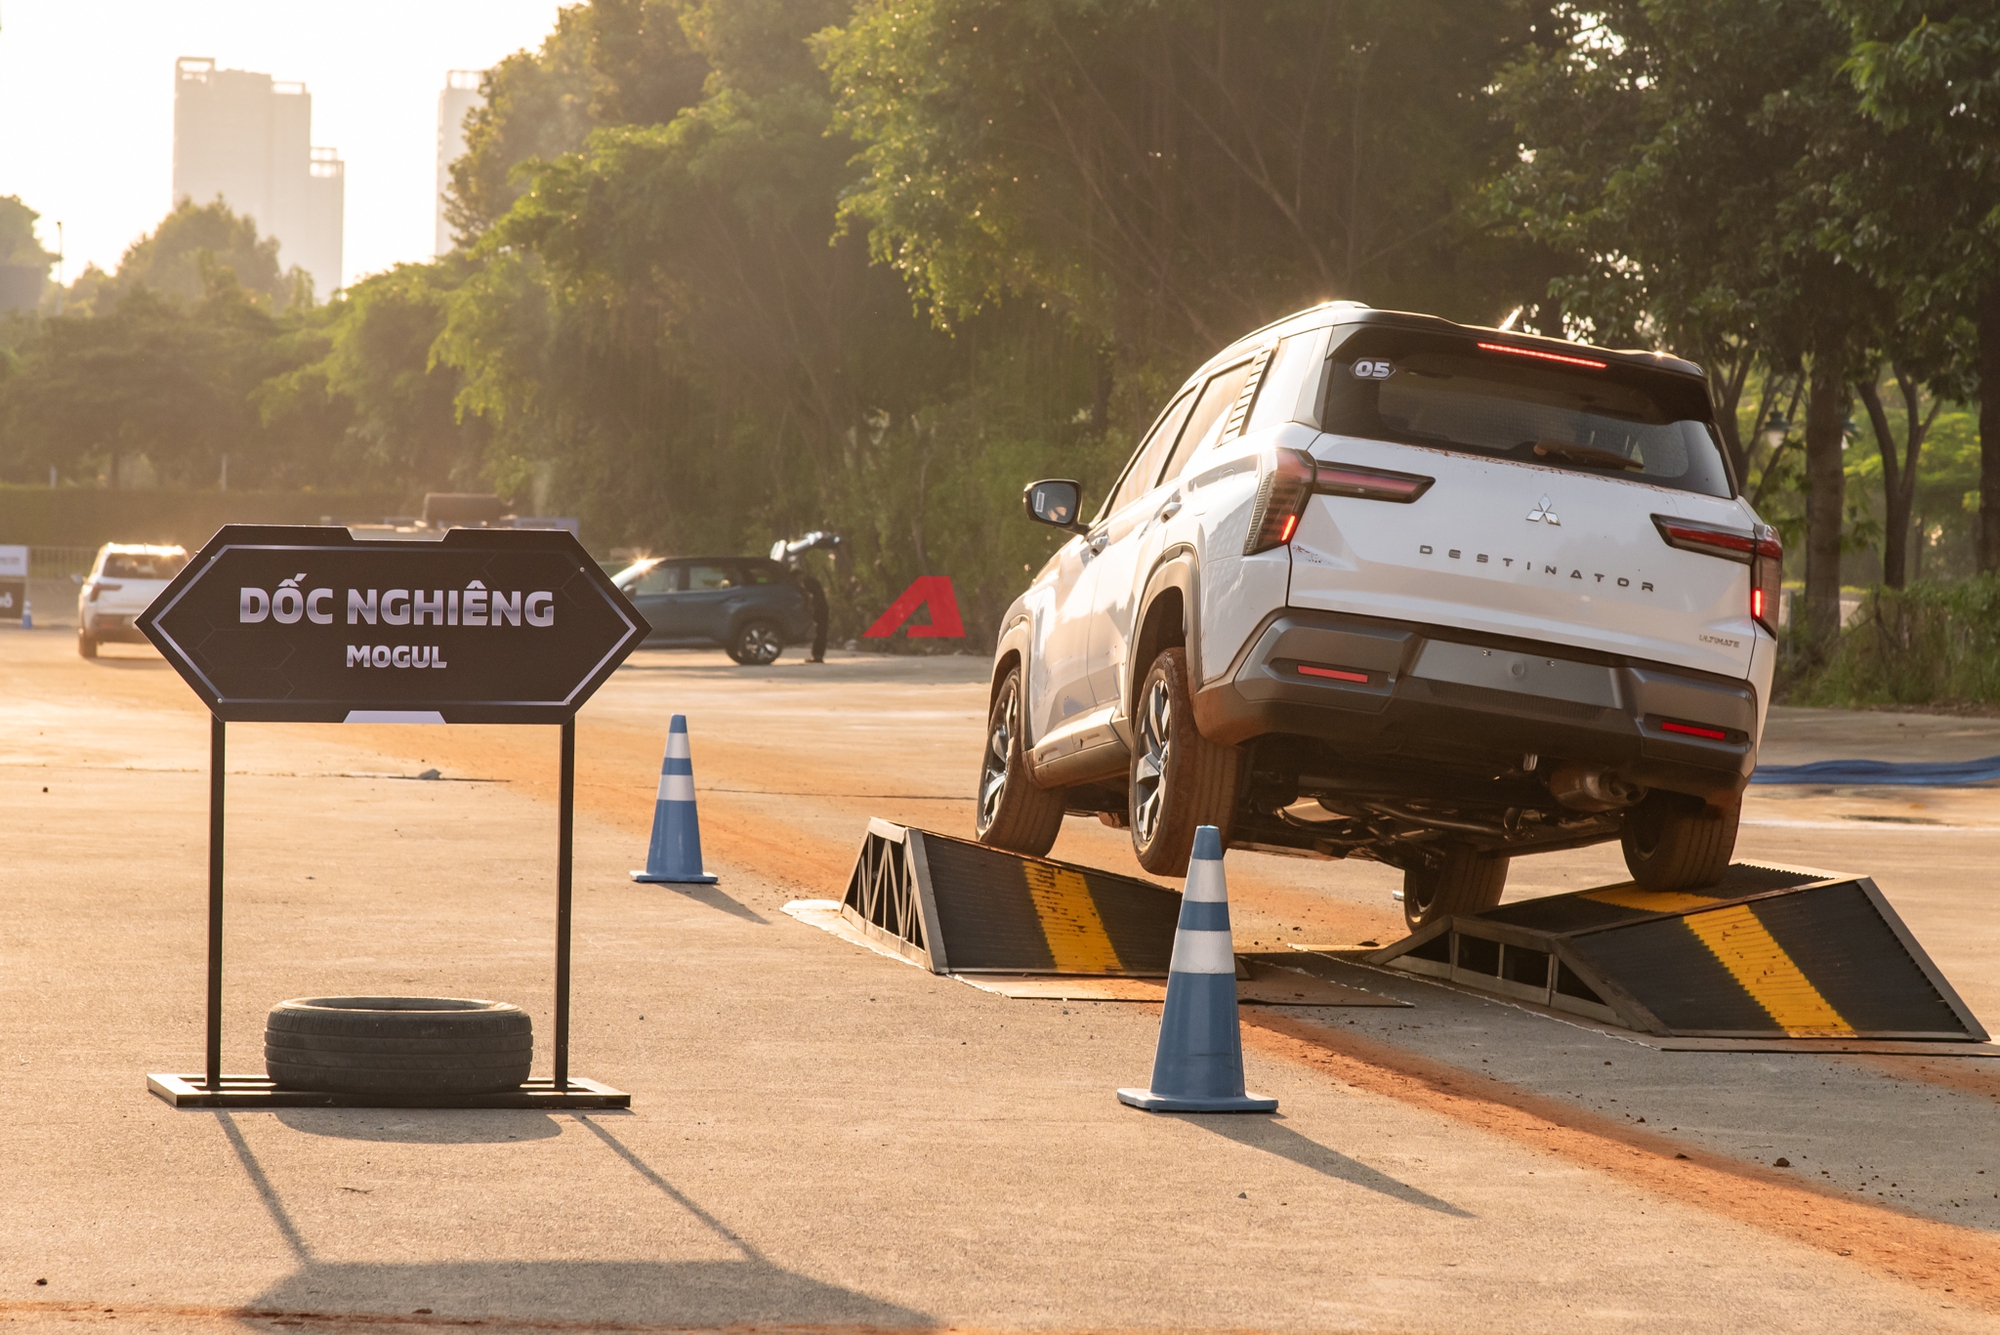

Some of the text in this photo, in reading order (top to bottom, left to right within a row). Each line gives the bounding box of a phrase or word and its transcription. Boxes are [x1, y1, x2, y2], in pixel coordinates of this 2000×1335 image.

[1355, 361, 1390, 378] 05
[1419, 543, 1655, 593] DESTINATOR
[239, 573, 555, 628] DỐC NGHIÊNG
[1699, 634, 1740, 649] ULTIMATE
[346, 645, 448, 669] MOGUL
